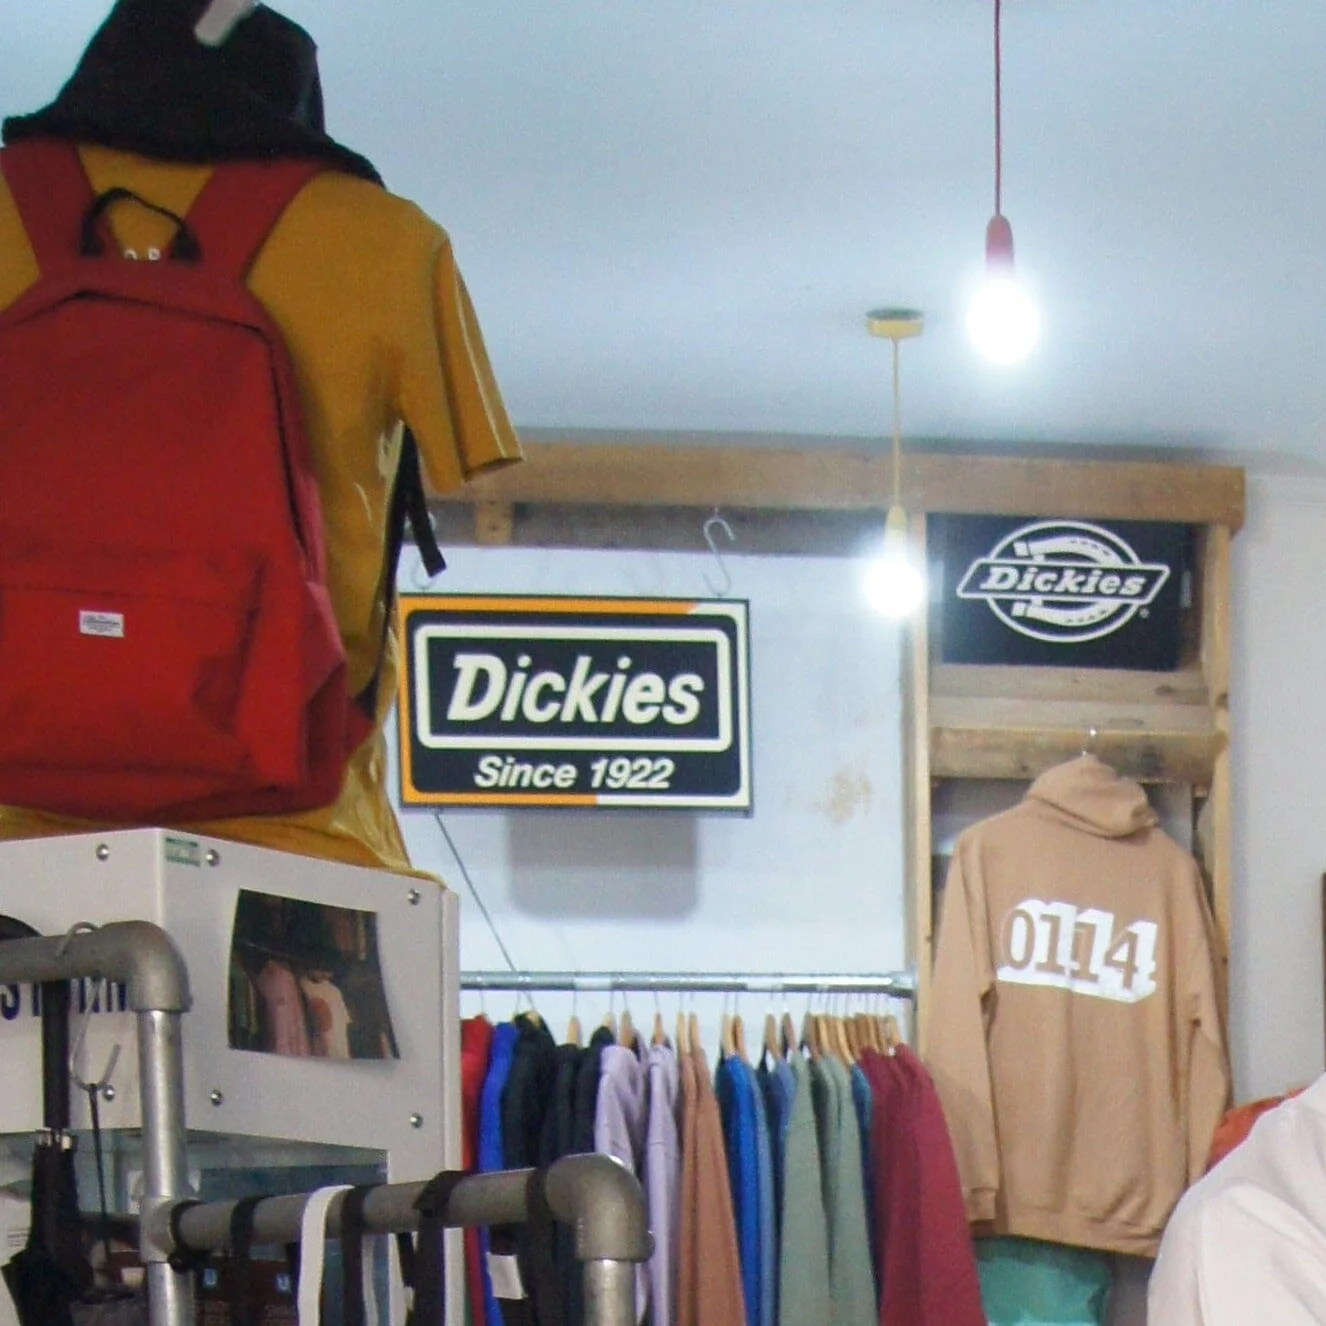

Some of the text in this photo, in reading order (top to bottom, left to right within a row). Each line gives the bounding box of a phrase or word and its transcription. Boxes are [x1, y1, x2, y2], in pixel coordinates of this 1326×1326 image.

[979, 566, 1148, 596] Dickies
[446, 653, 705, 725] Dickies
[473, 755, 676, 790] Since 1922
[999, 903, 1148, 997] 0114
